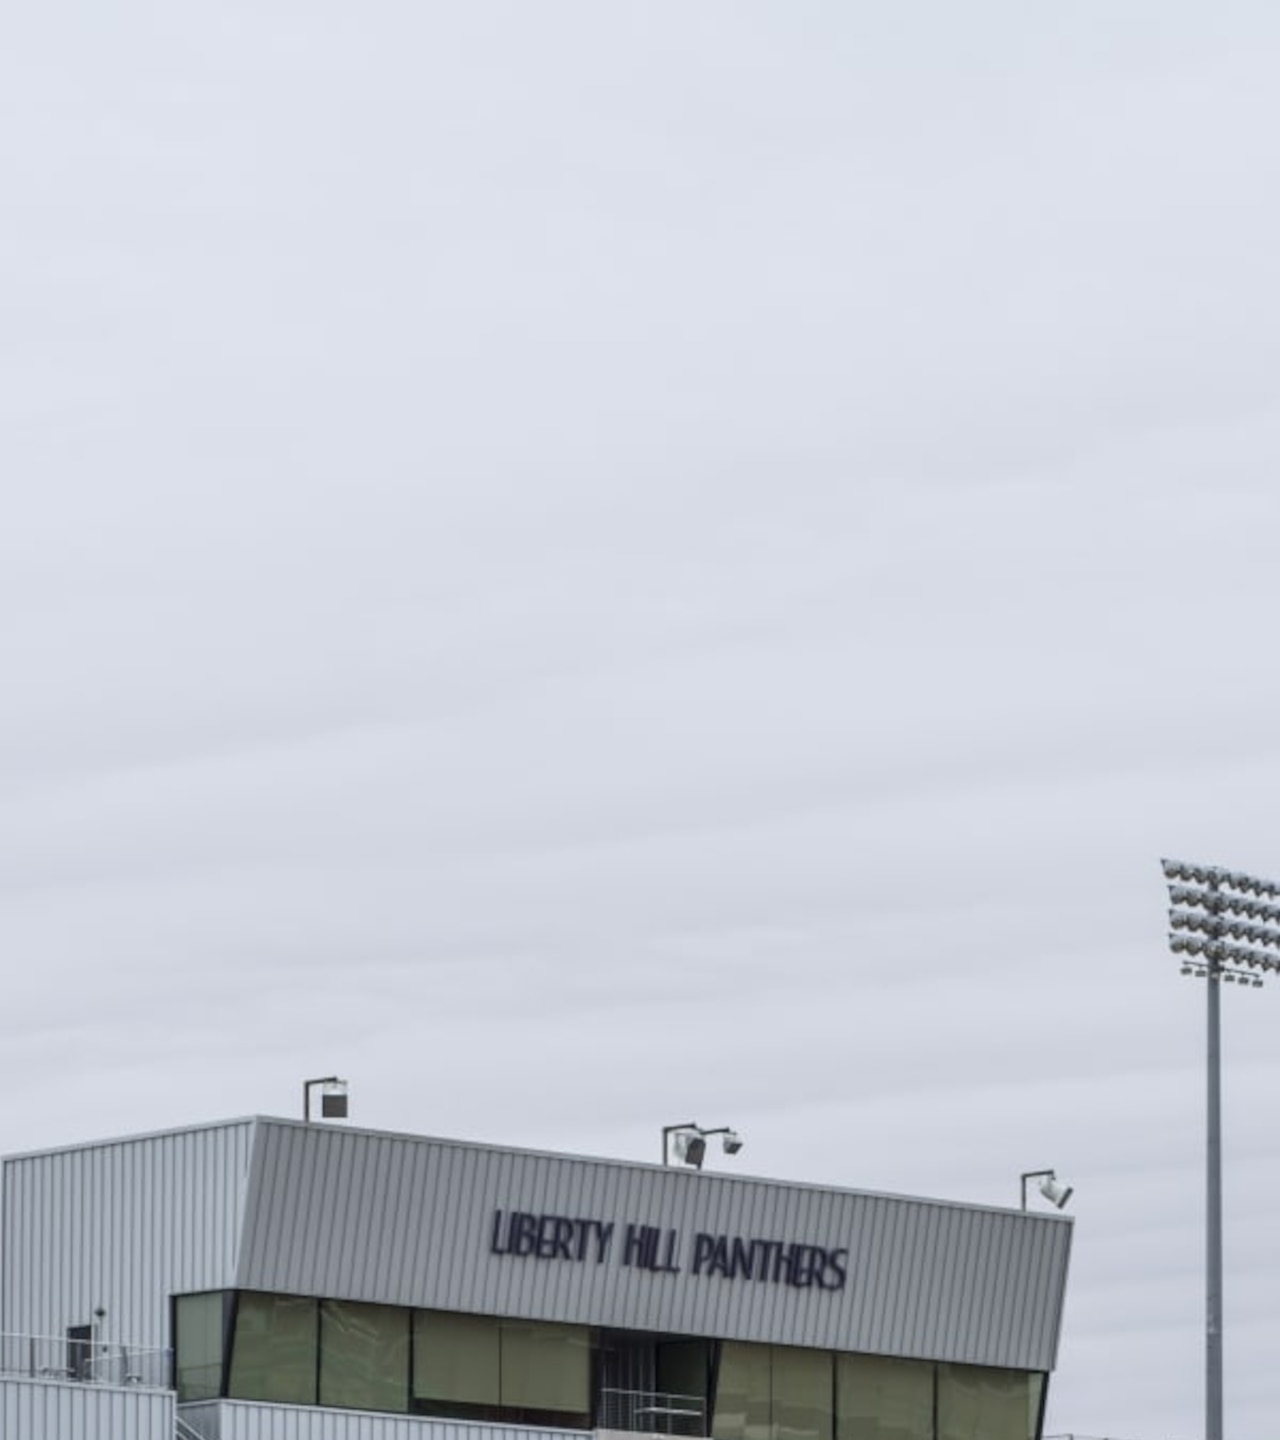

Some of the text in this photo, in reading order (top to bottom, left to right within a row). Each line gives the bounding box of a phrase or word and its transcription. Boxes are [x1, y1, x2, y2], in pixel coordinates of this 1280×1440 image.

[490, 1208, 849, 1293] LIBERTY HILL PANTHERS
